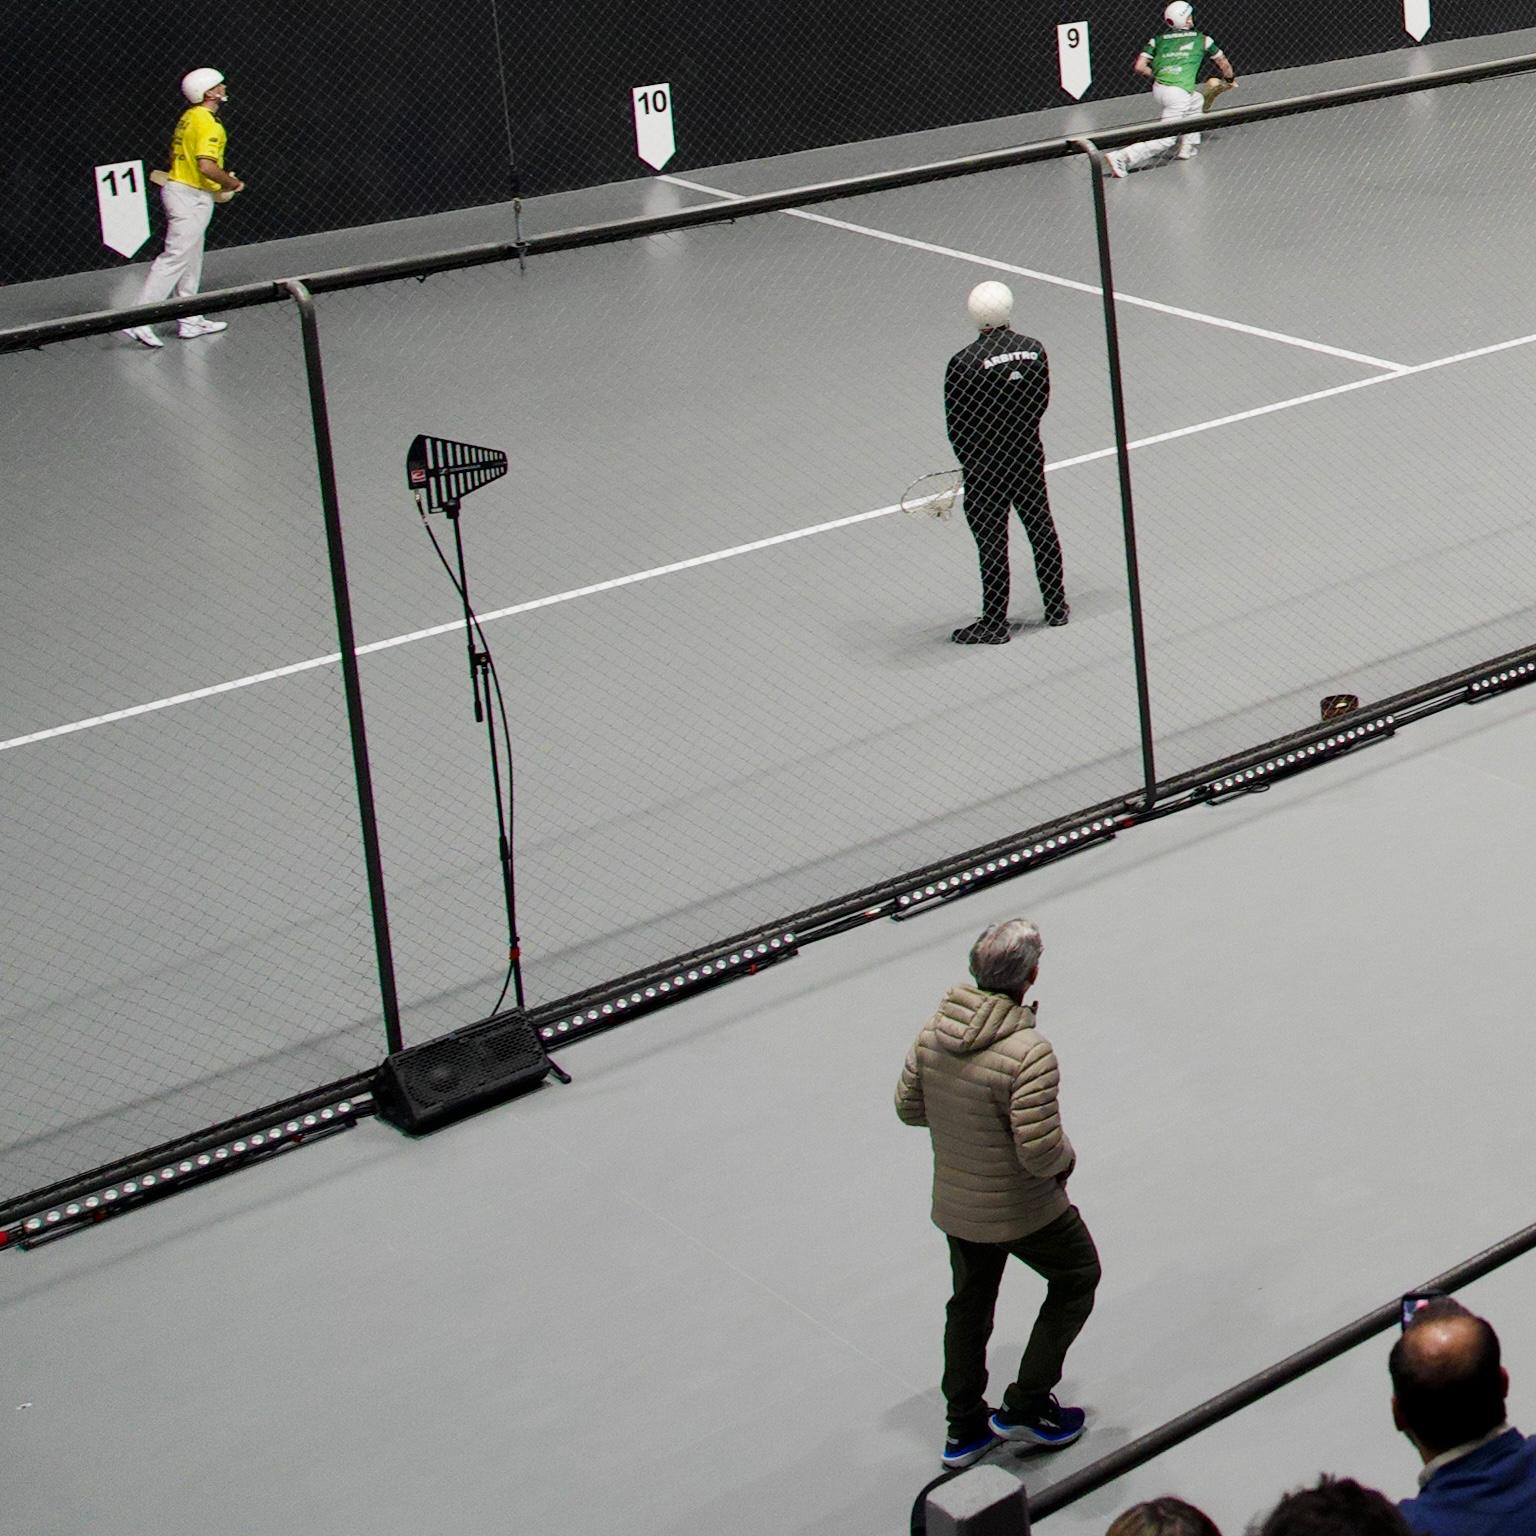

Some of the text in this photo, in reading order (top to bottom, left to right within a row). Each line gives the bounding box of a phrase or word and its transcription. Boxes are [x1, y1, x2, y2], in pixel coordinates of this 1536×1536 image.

[1066, 27, 1080, 49] 9
[637, 89, 668, 116] 10
[101, 167, 140, 198] 11
[983, 350, 1039, 370] ARBITRO
